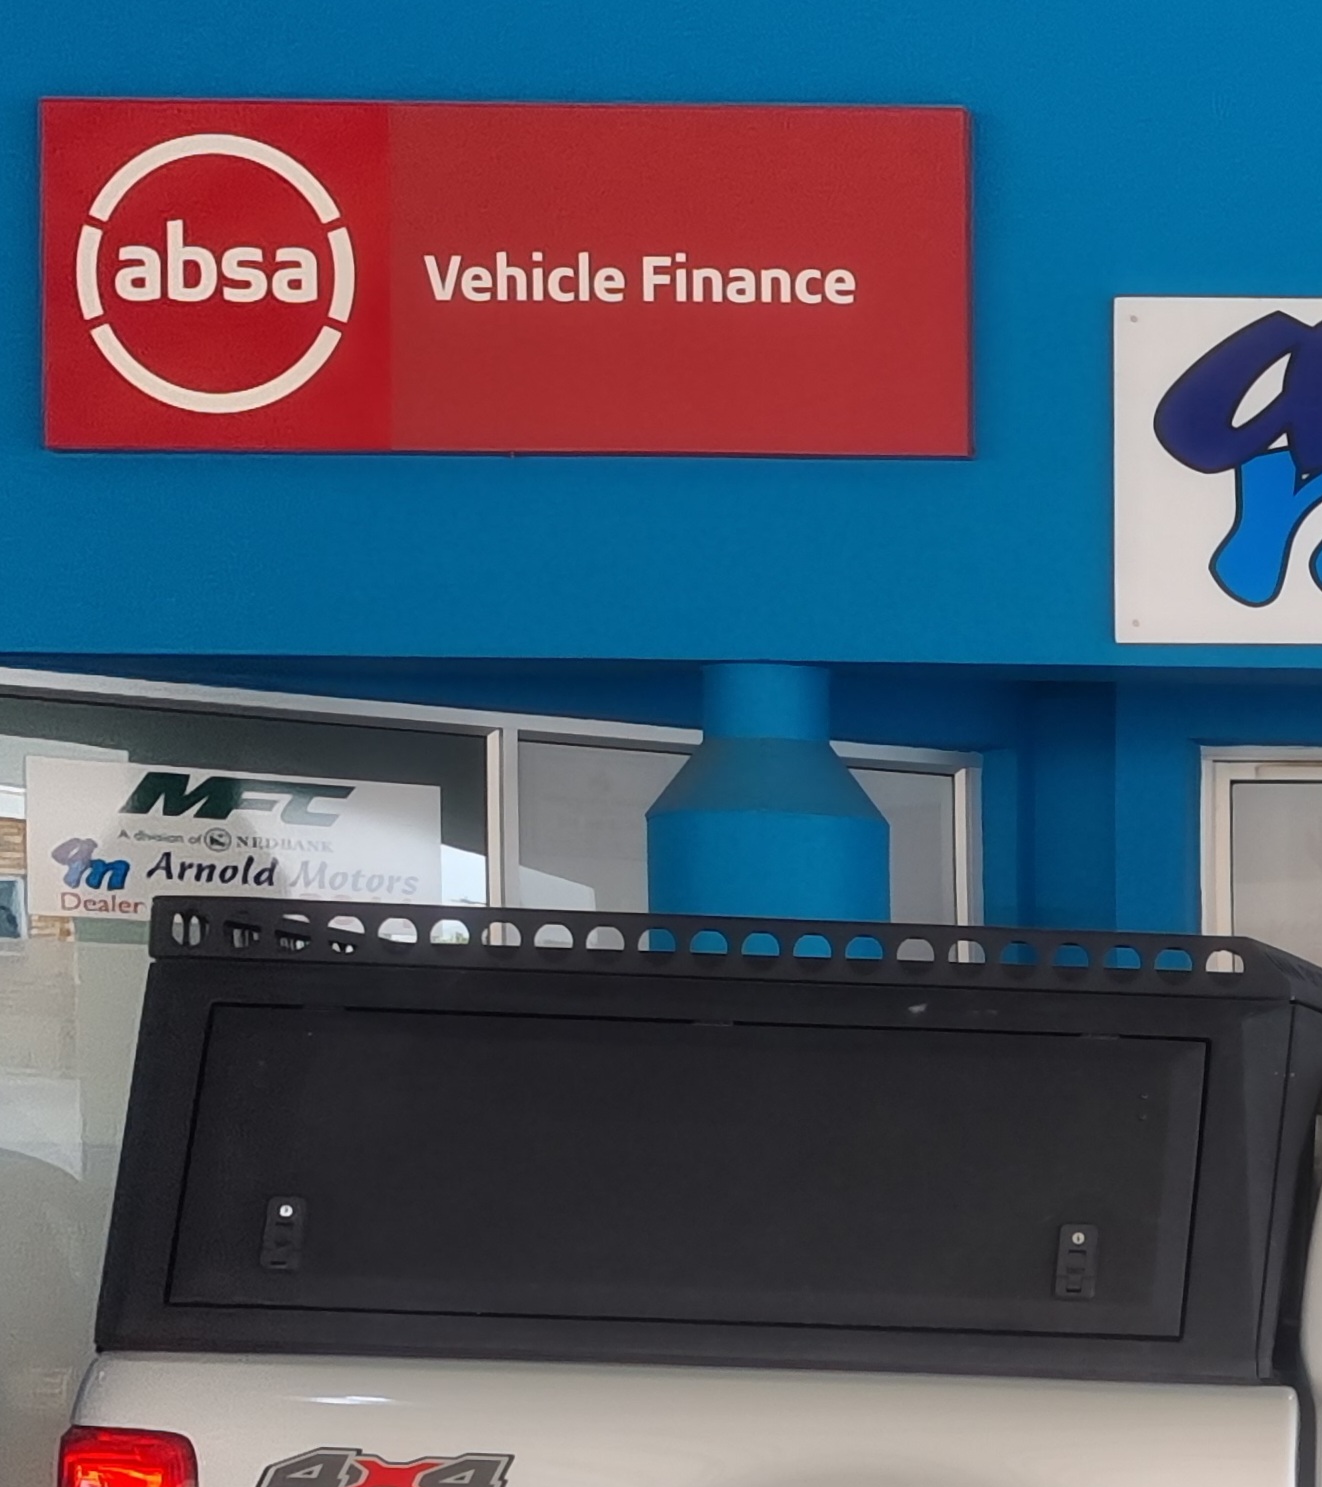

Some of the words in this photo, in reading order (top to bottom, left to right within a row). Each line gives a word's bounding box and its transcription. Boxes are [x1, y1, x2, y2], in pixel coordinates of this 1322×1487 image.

[115, 219, 318, 303] absa
[423, 251, 626, 302] Vehicle
[642, 253, 856, 304] Finance
[118, 771, 356, 827] MFC
[236, 835, 335, 854] NEDBANK
[146, 852, 278, 887] Arnold
[289, 859, 419, 896] Motors
[61, 892, 145, 915] Dealer
